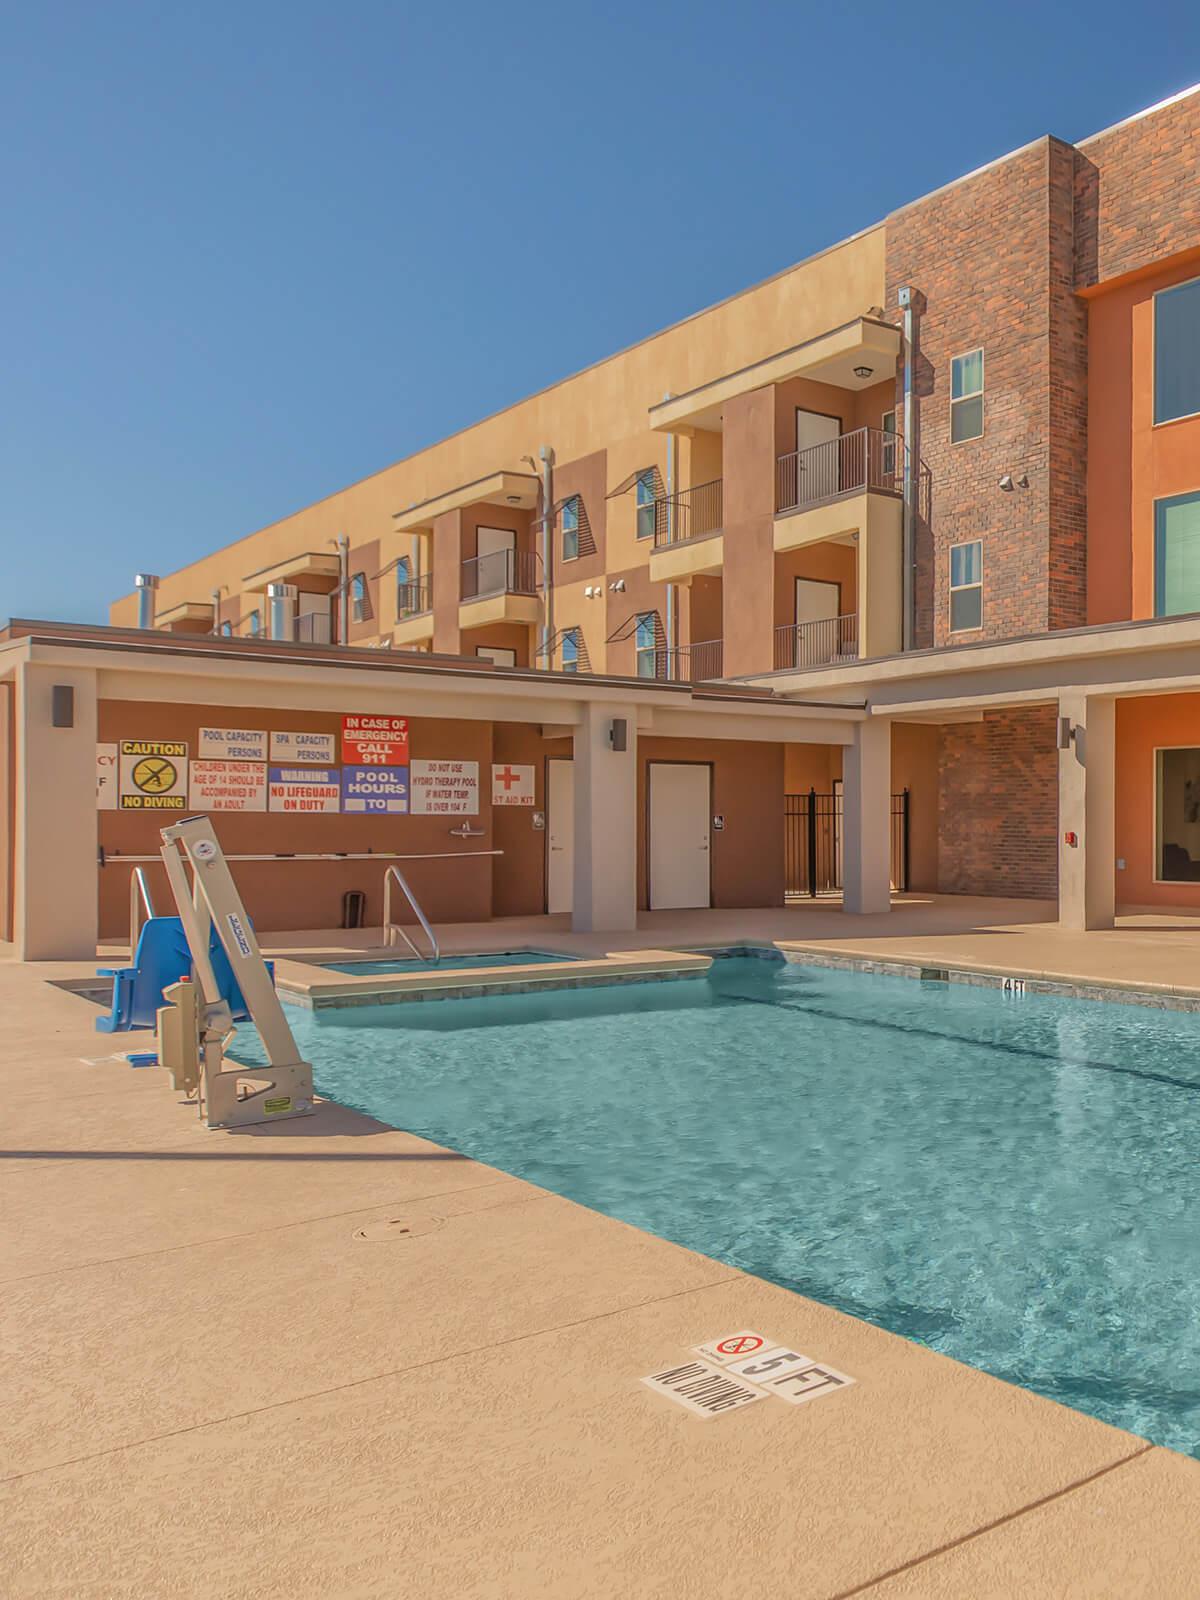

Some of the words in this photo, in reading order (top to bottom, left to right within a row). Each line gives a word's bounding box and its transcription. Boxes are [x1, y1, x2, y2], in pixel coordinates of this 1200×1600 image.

[347, 718, 359, 728] IN
[361, 719, 390, 729] CASE
[392, 720, 406, 730] OF
[203, 730, 225, 740] POOL
[227, 731, 265, 742] CAPACITY
[276, 734, 290, 744] SPA
[296, 735, 330, 746] CAPACITY
[344, 730, 408, 742] EMERGENCY
[123, 743, 185, 755] CAUTION
[228, 747, 263, 758] PERSONS
[357, 743, 392, 754] CALL
[297, 750, 330, 760] PERSONS
[362, 754, 387, 764] 911
[193, 762, 226, 773] CHILDREN
[229, 763, 251, 773] UNDER
[252, 764, 265, 774] THE
[428, 763, 437, 773] DO
[438, 764, 450, 773] NOT
[451, 764, 463, 773] USE
[193, 775, 208, 784] AGE
[209, 775, 218, 784] OF
[228, 776, 254, 785] SHOULD
[256, 777, 265, 786] BE
[356, 771, 398, 782] POOL
[434, 776, 461, 787] THERAPY
[461, 777, 477, 788] POOL
[201, 787, 247, 798] ACCOMPANIED
[248, 788, 258, 799] BY
[271, 787, 285, 797] NO
[287, 787, 338, 798] LIFEGUARD
[348, 783, 406, 794] HOURS
[432, 790, 452, 800] WATER
[505, 796, 518, 804] AID
[520, 796, 534, 805] KIT
[123, 797, 141, 807] NO
[143, 797, 184, 808] DIVING
[213, 800, 222, 810] AN
[224, 800, 246, 810] ADULT
[284, 800, 297, 810] ON
[300, 800, 325, 811] DUTY
[368, 799, 386, 809] TO
[433, 803, 449, 812] OVER
[1004, 978, 1012, 990] 4
[1014, 979, 1025, 993] FT
[651, 1363, 708, 1385] NO
[742, 1353, 801, 1375] 5
[773, 1367, 845, 1397] FT
[673, 1374, 757, 1413] DIVING
